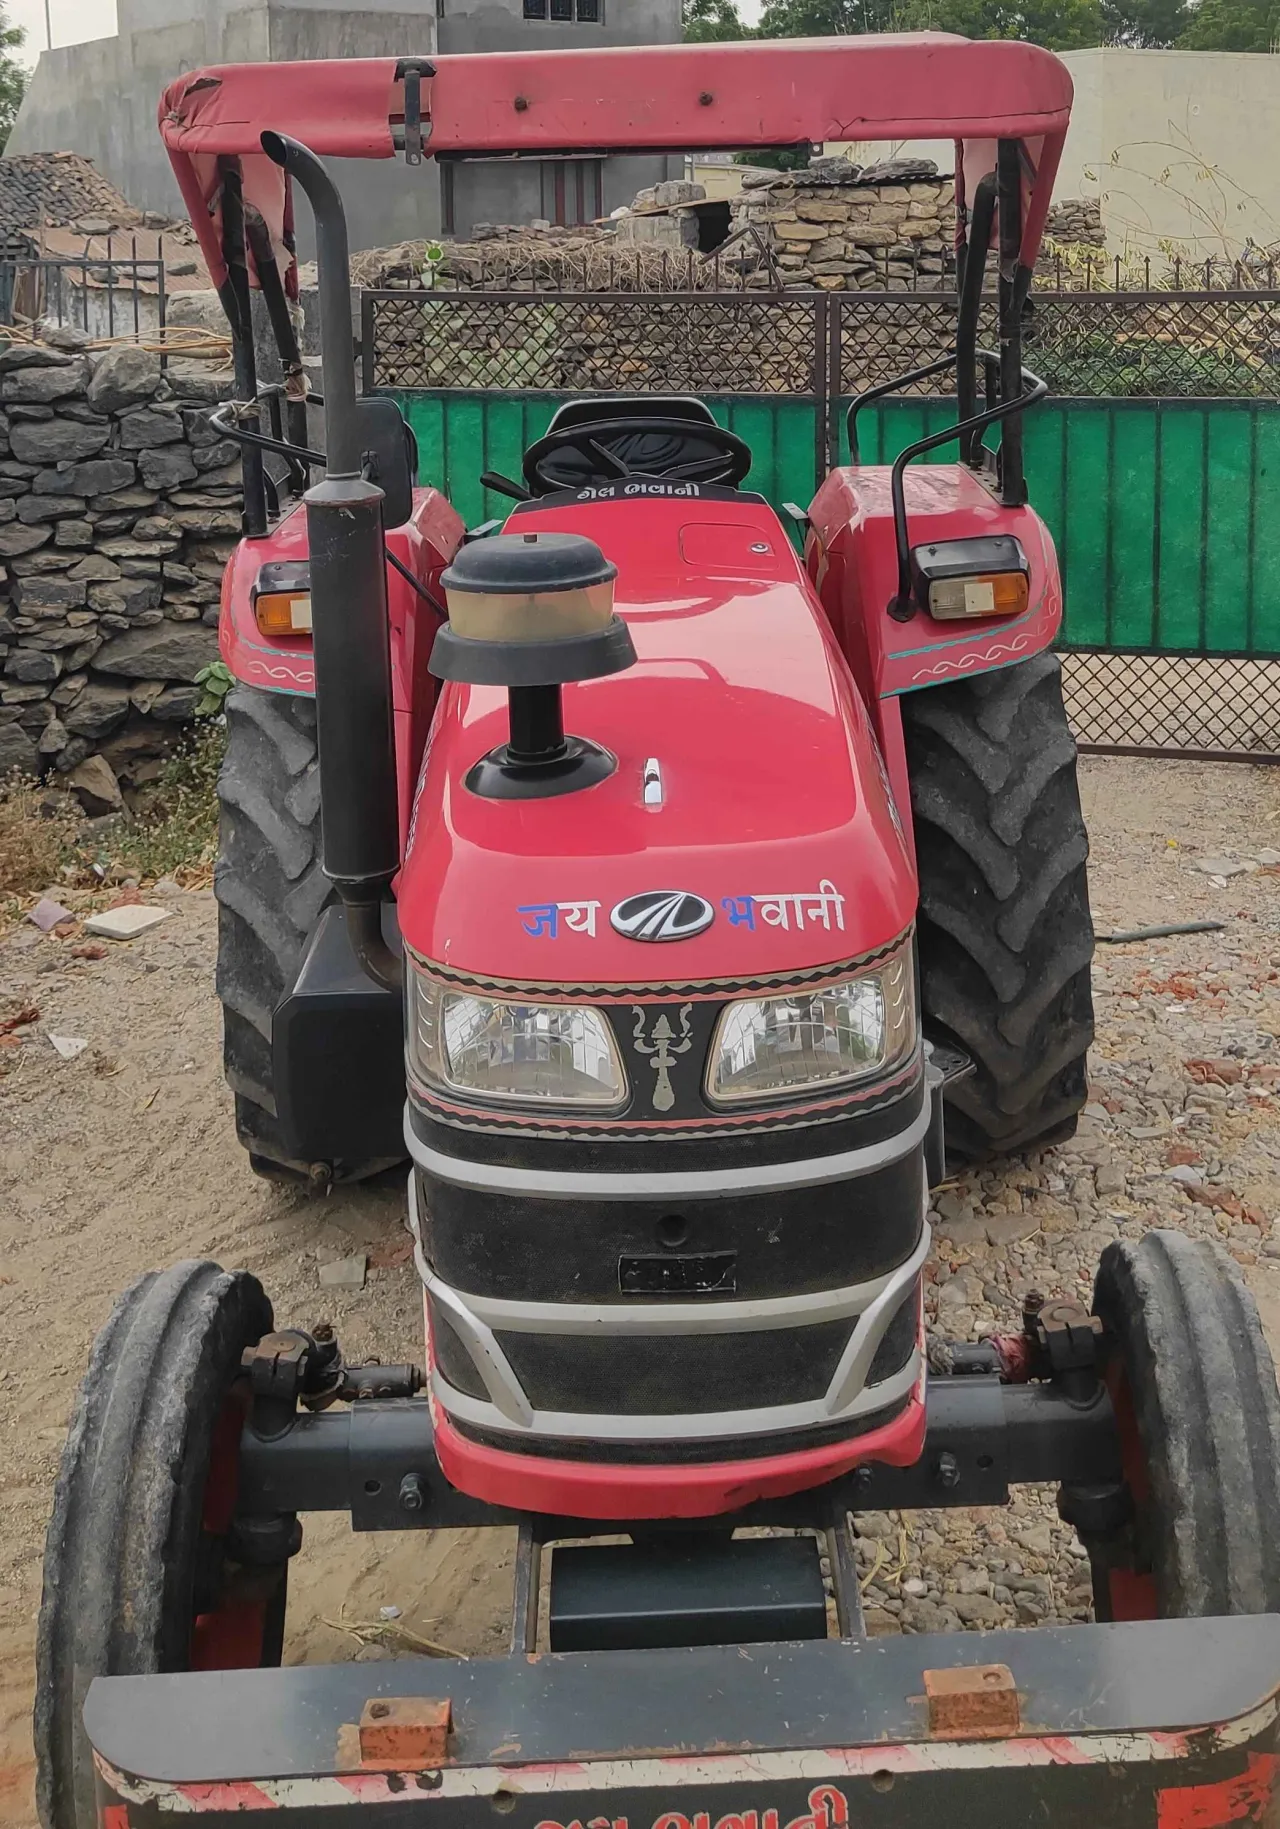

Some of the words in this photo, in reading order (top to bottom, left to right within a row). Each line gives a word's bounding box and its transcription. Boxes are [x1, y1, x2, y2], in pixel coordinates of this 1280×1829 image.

[623, 482, 701, 497] ભવાની
[515, 900, 602, 939] जय
[720, 879, 846, 932] भवानी
